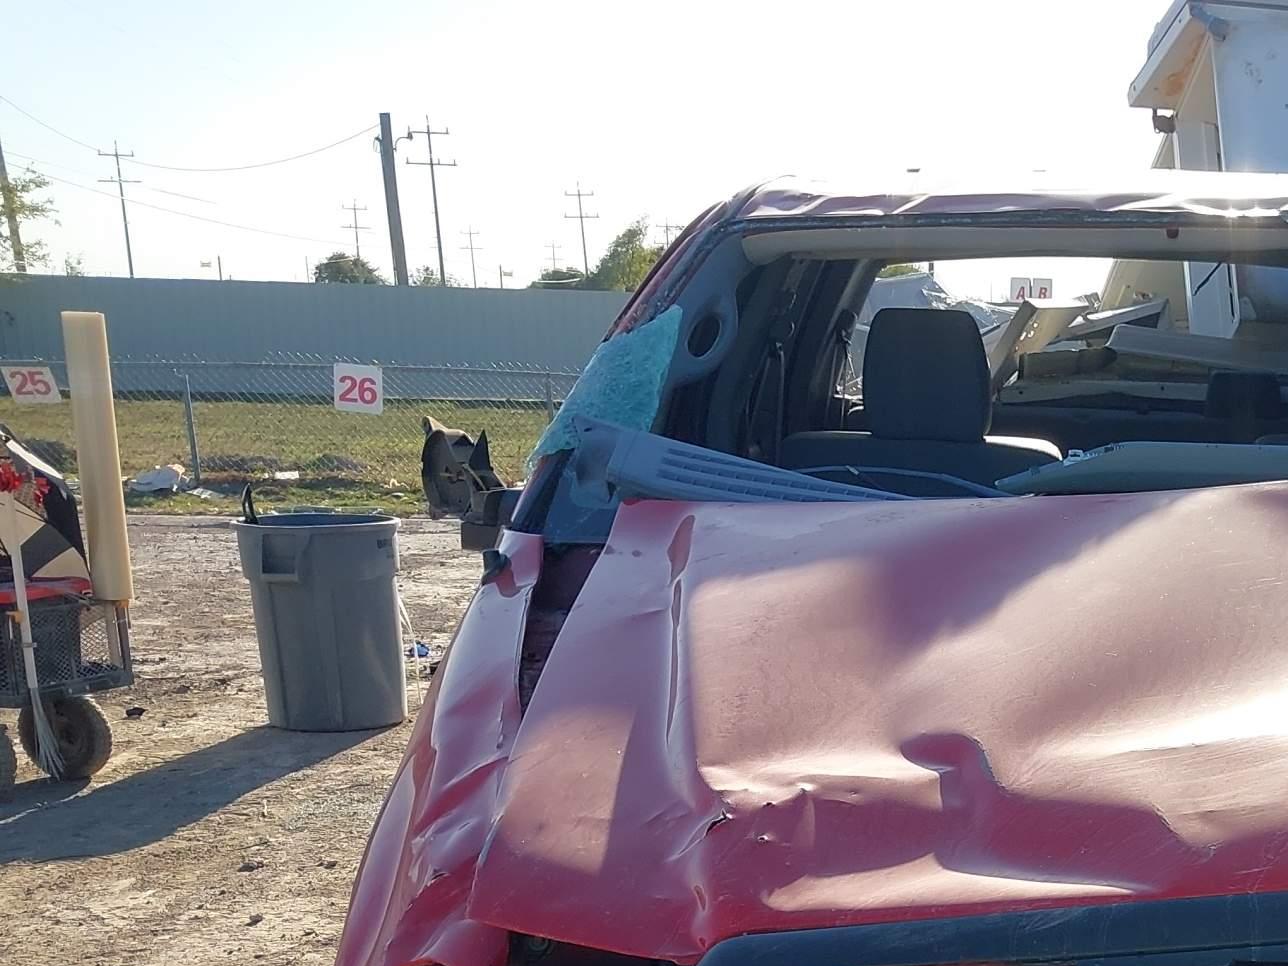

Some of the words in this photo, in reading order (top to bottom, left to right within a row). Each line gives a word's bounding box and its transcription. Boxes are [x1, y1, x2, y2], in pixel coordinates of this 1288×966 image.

[1016, 286, 1026, 300] A
[1038, 286, 1048, 299] B
[9, 370, 51, 396] 25
[339, 375, 378, 405] 26
